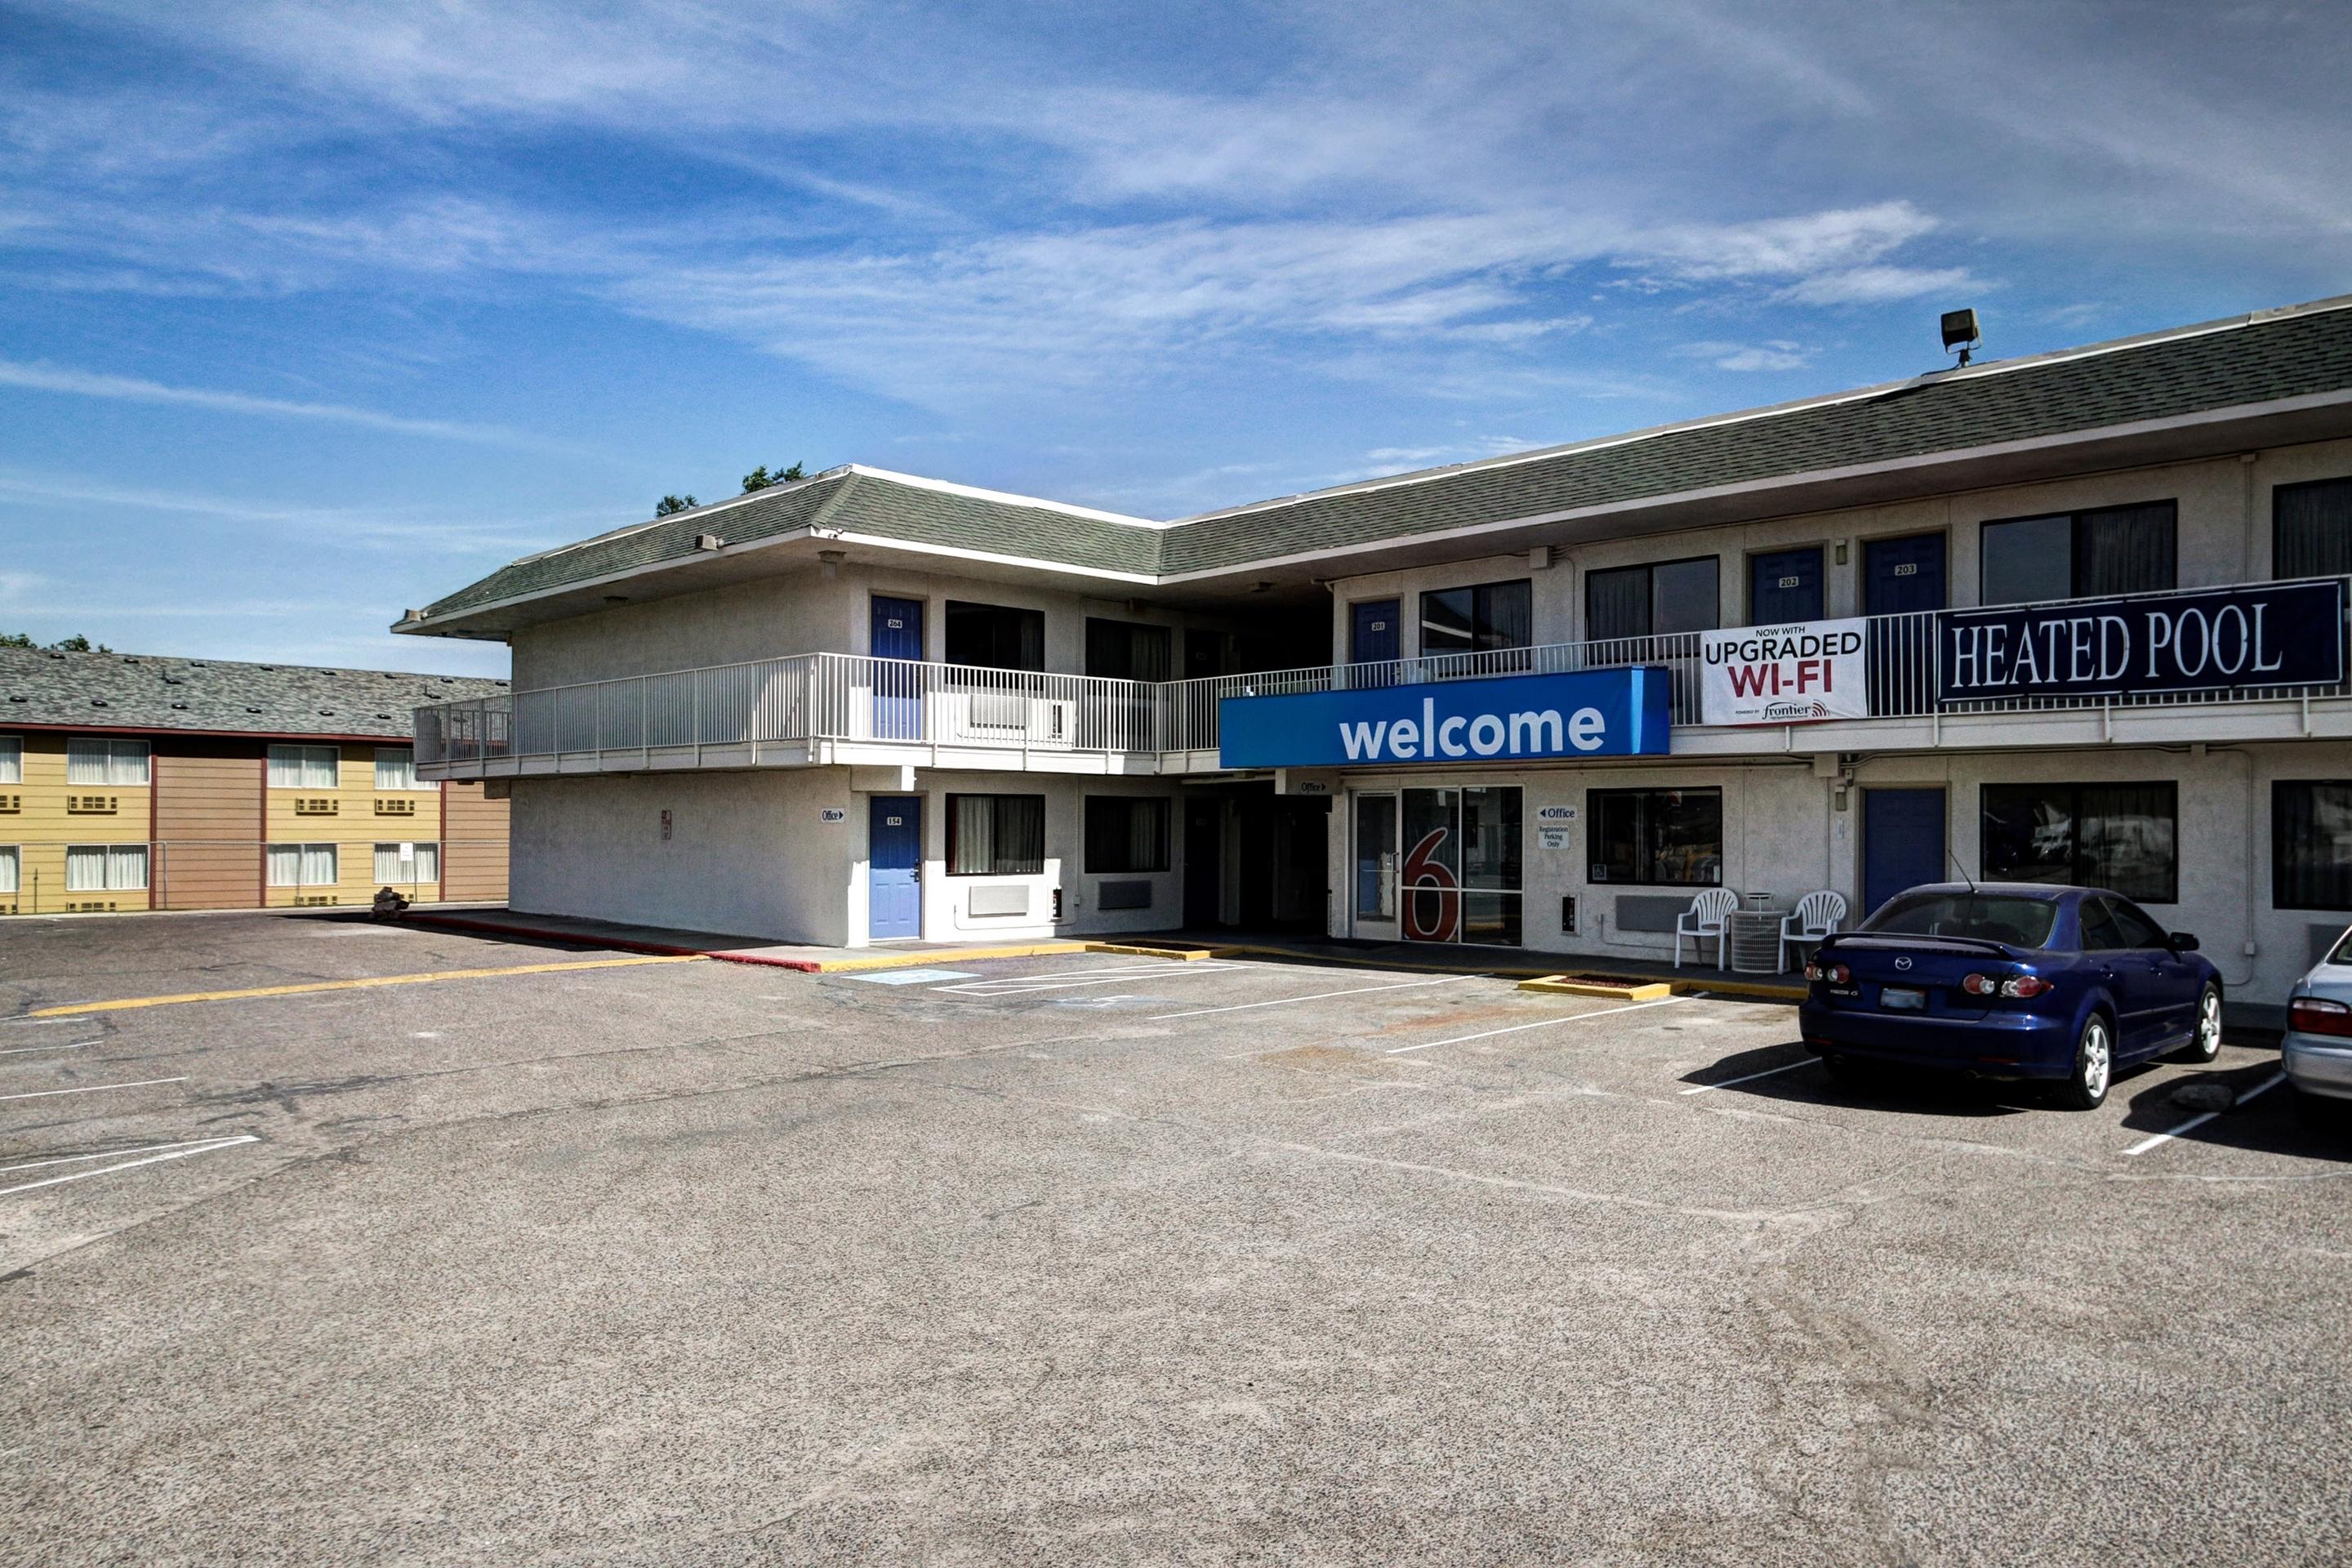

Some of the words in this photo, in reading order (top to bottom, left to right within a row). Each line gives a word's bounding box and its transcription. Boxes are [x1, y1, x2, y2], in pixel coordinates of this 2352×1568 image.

[1896, 565, 1915, 575] 203
[1780, 577, 1797, 586] 202
[1756, 628, 1780, 637] NOW
[1782, 626, 1806, 635] WITH
[1705, 632, 1862, 665] UPGRADED
[1950, 616, 2130, 688] HEATED
[2145, 604, 2283, 678] POOL
[1727, 659, 1832, 698] WI-FI
[1762, 702, 1811, 720] frontier
[1339, 697, 1606, 760] welcome
[1301, 782, 1321, 791] Office
[822, 809, 839, 821] Office
[1548, 808, 1575, 818] Office
[1404, 826, 1459, 942] 6
